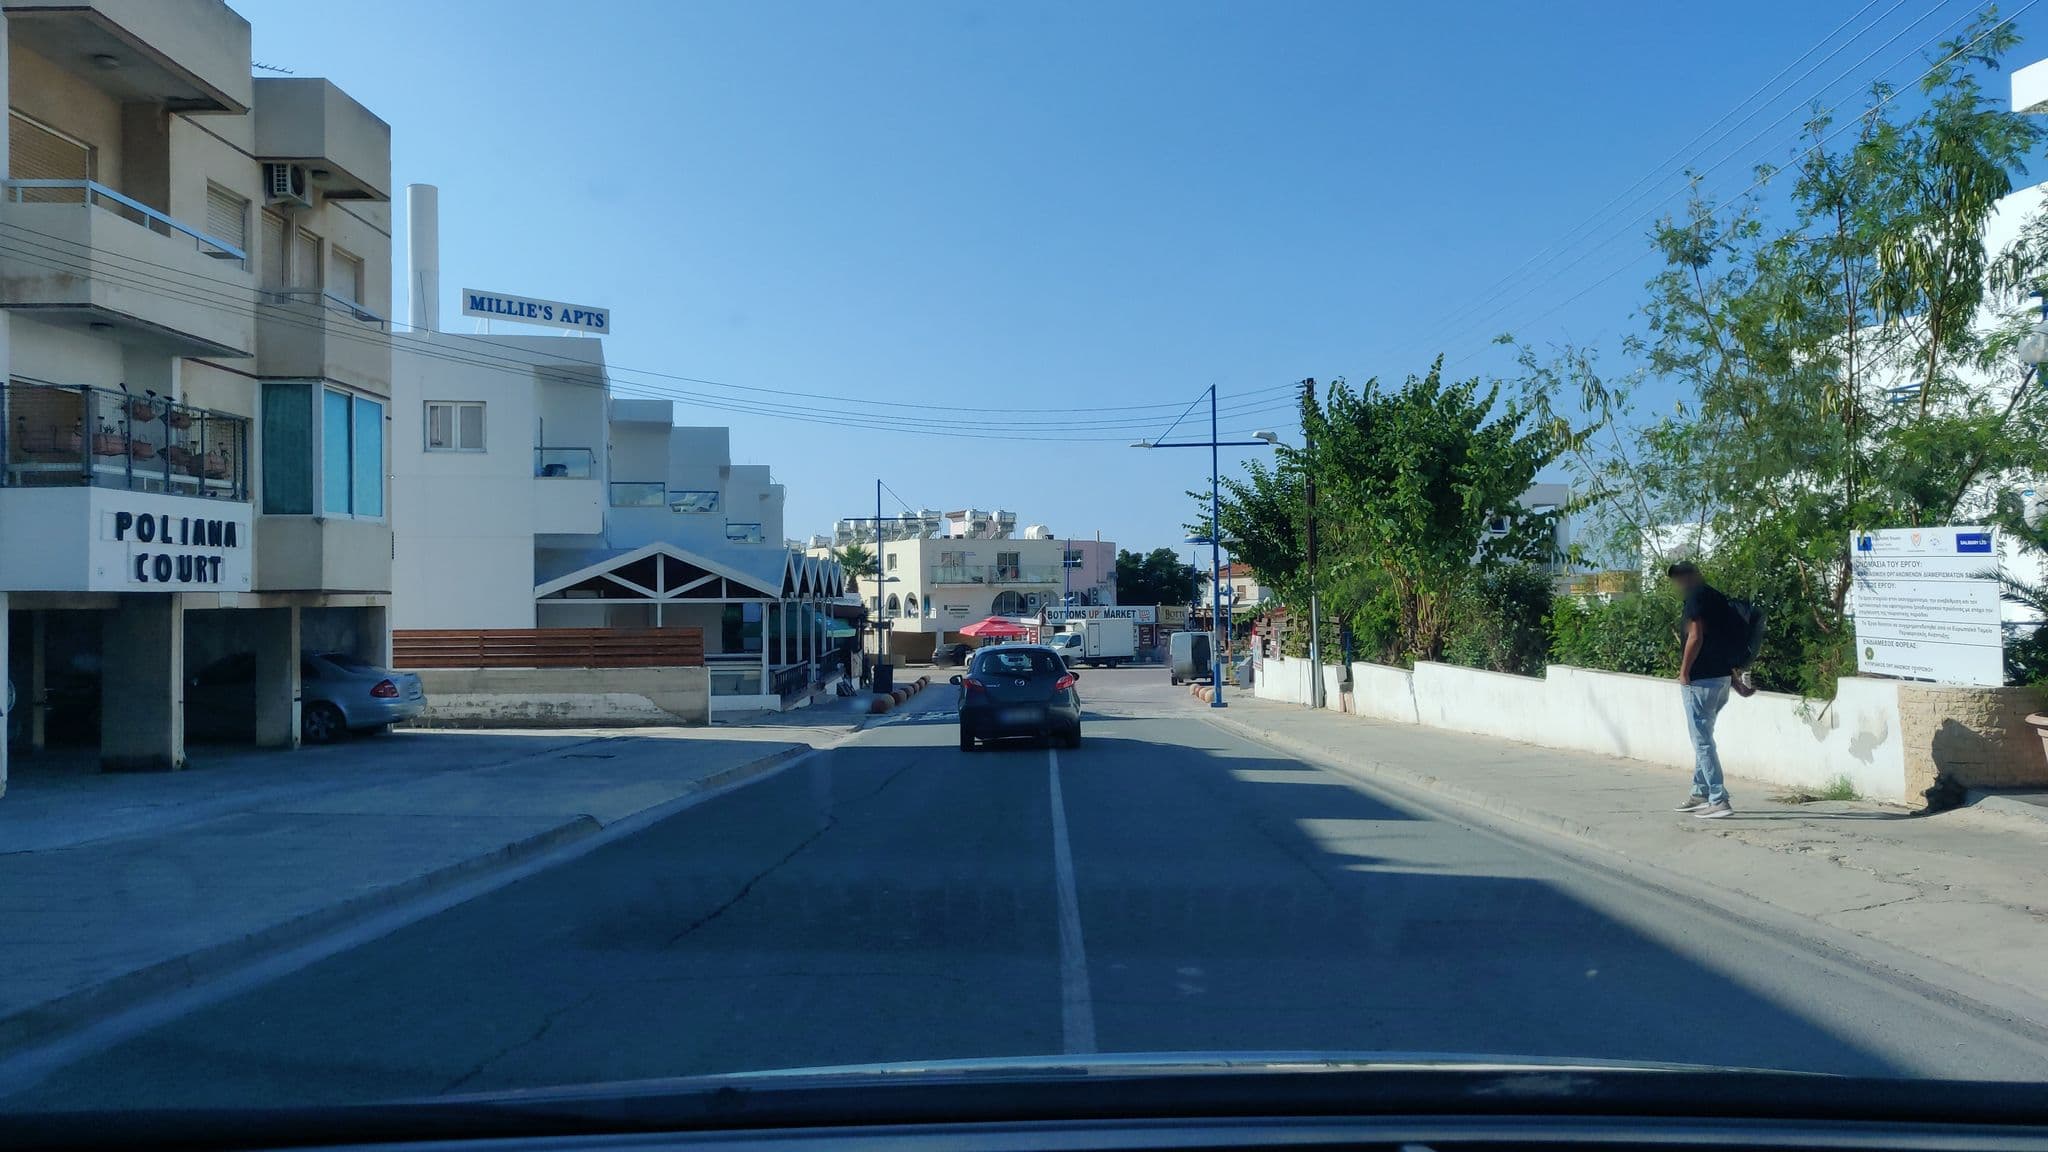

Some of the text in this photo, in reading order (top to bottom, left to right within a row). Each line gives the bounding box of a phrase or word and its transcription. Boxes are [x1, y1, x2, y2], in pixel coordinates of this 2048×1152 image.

[469, 294, 605, 328] MILLIE'S APTS
[115, 511, 237, 548] POLIANA
[136, 553, 222, 583] COURT
[1088, 610, 1100, 619] UP
[1103, 608, 1137, 619] MARKET
